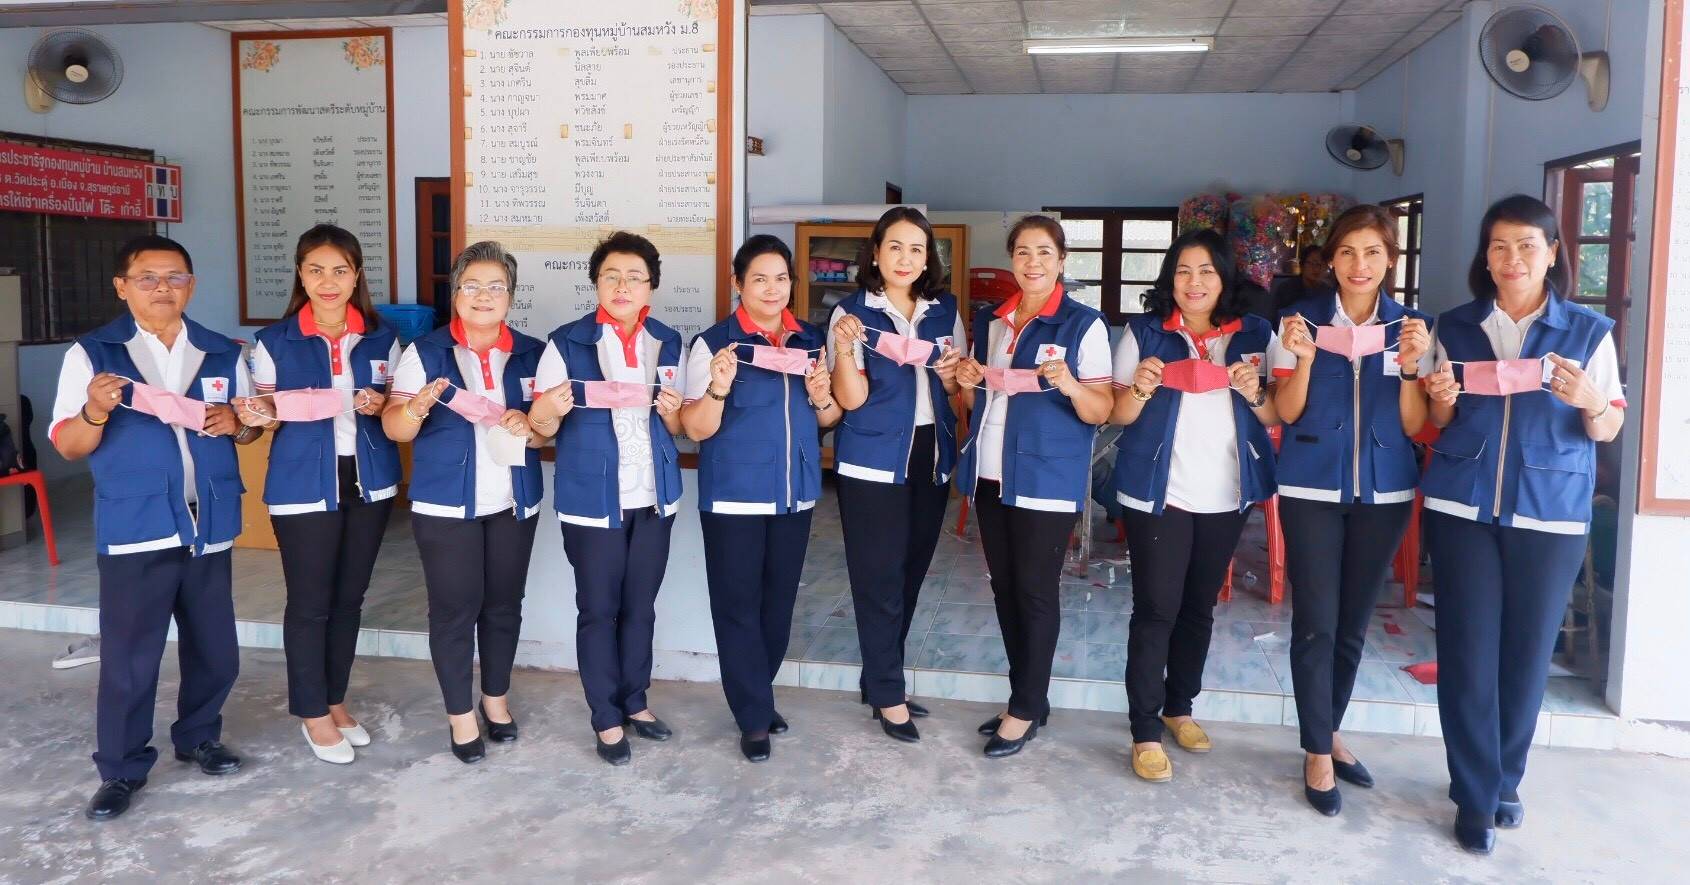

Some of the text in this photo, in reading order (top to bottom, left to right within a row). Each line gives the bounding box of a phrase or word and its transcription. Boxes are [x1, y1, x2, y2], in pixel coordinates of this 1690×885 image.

[495, 21, 700, 42] คณะกรรมการกองทุนหมู่บ้านสมหวัง ม.8
[0, 149, 101, 177] รประชารัฐกองทุนหมู่บ้าน
